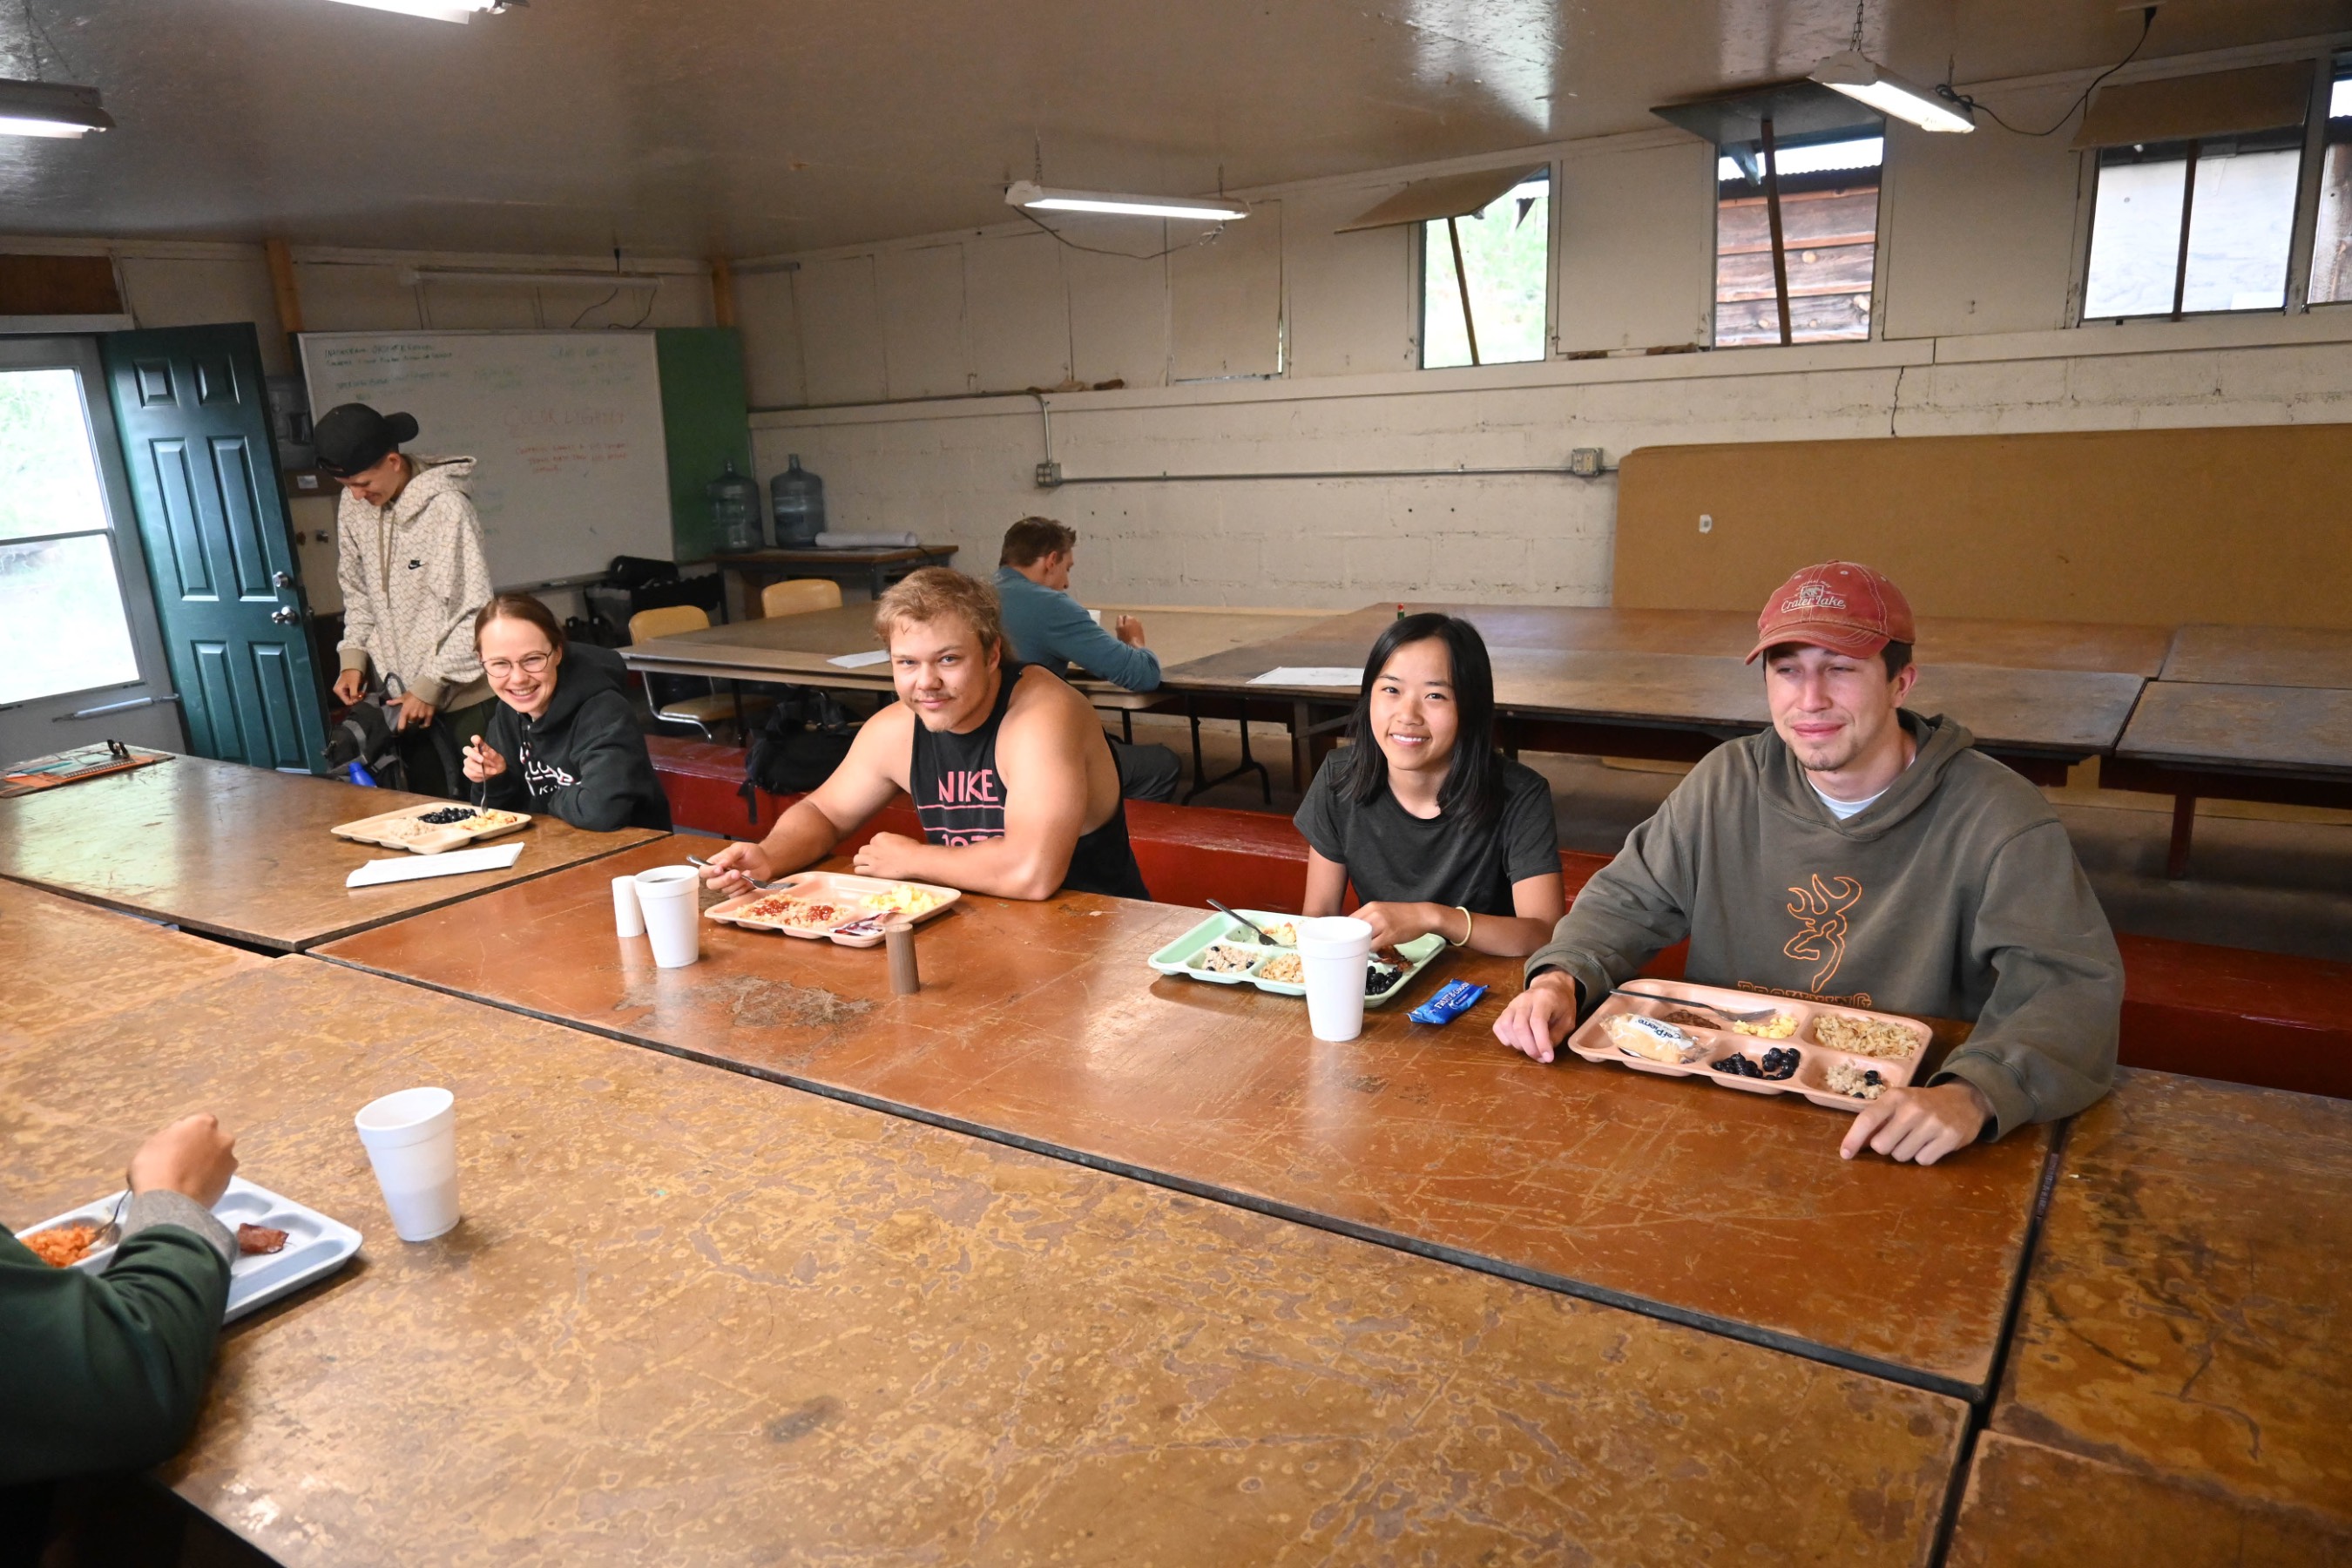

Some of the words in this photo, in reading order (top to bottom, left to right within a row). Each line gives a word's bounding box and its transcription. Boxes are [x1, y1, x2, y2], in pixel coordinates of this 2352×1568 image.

[1781, 597, 1813, 612] Crater
[1815, 595, 1845, 608] Lake
[938, 769, 998, 802] NIKE
